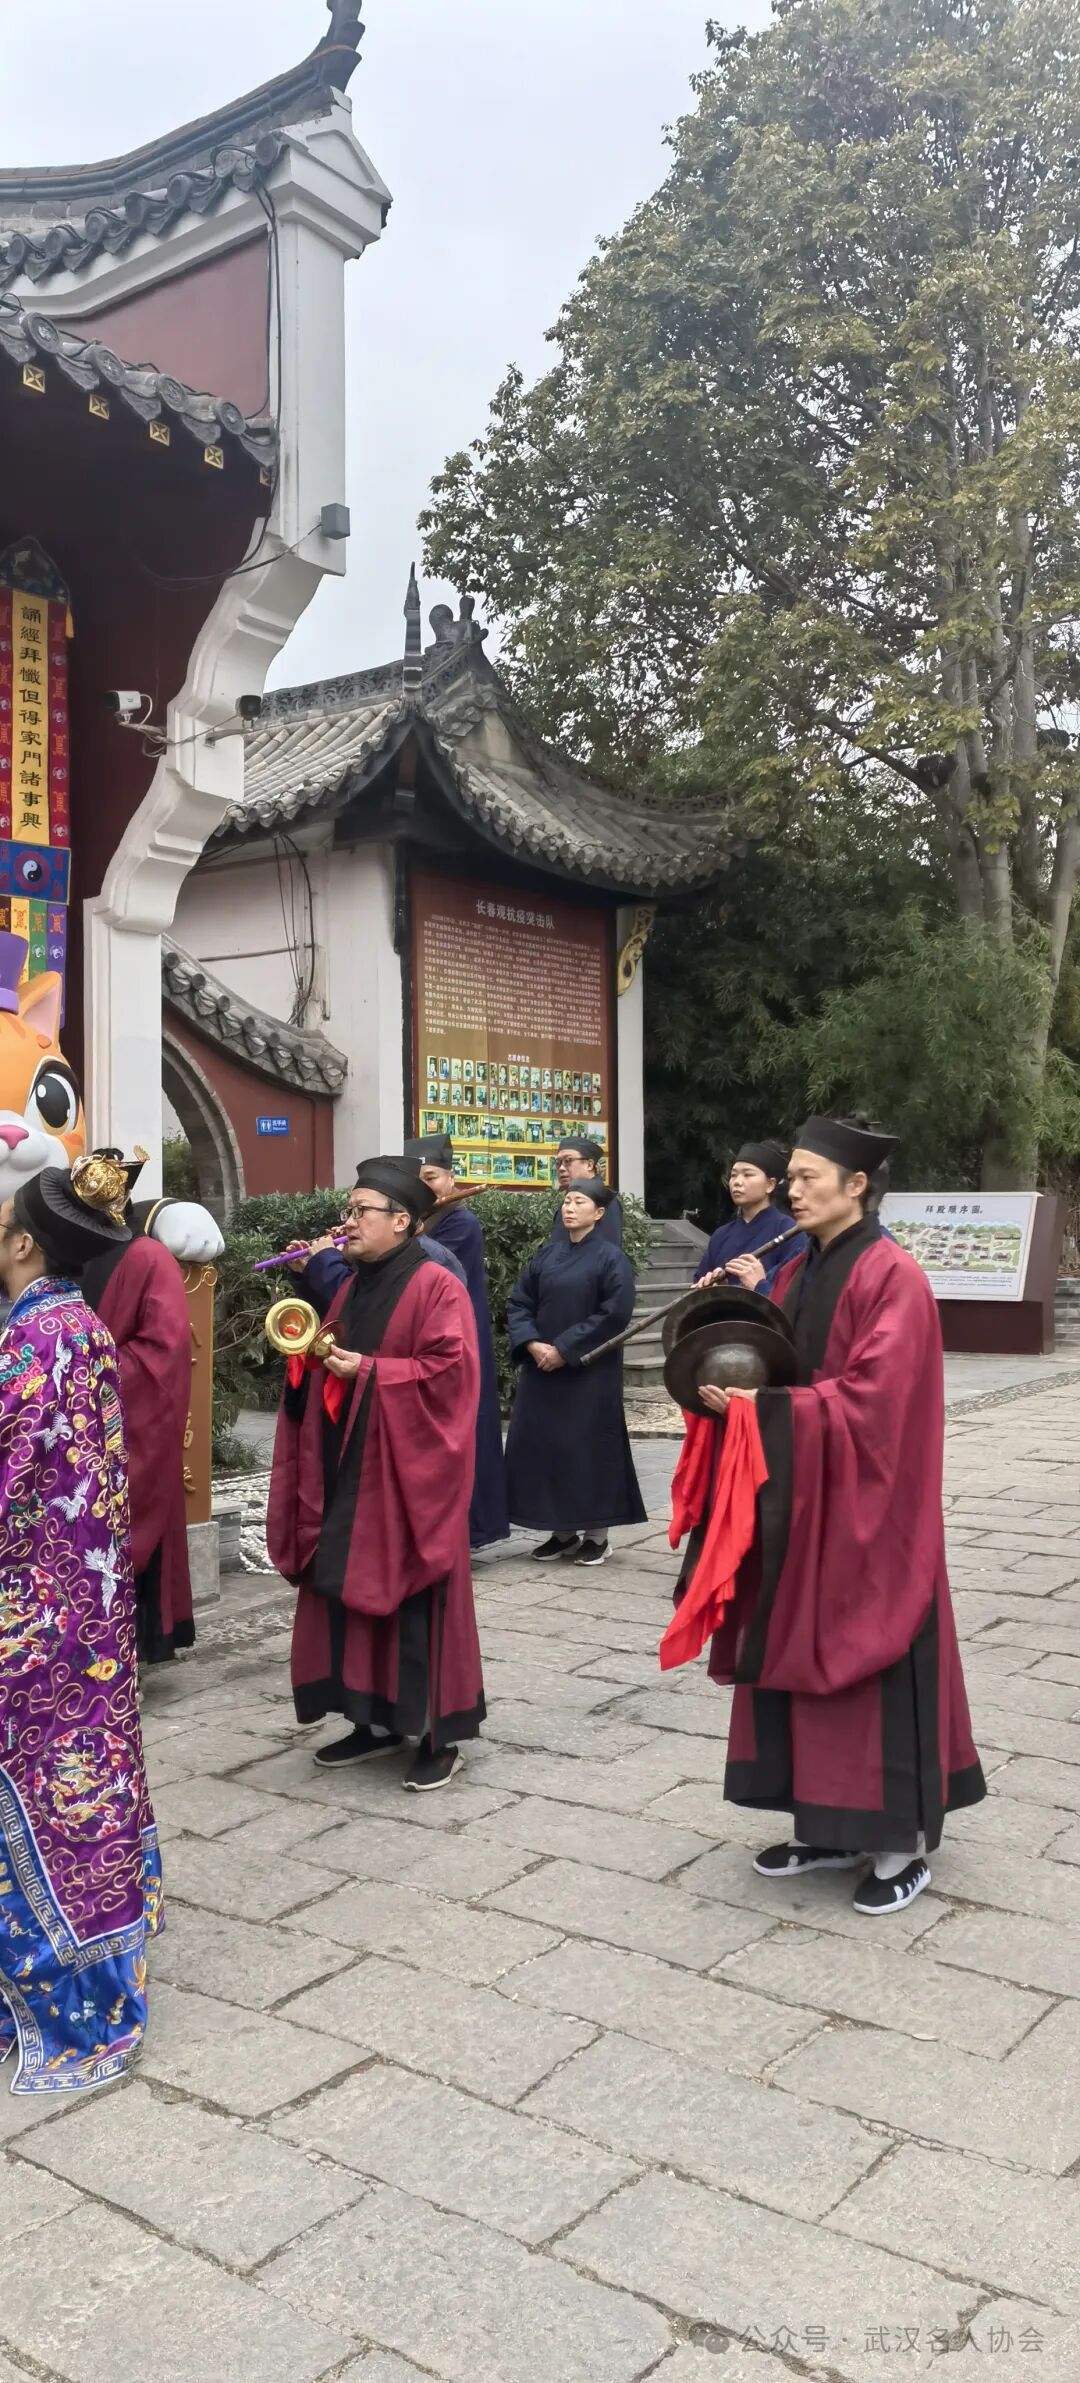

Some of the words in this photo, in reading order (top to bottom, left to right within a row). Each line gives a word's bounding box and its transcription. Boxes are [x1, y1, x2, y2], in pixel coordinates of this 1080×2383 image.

[19, 605, 42, 829] 誦經拜懺但得家門諸事興
[475, 898, 556, 930] 长春观抗疫突击队
